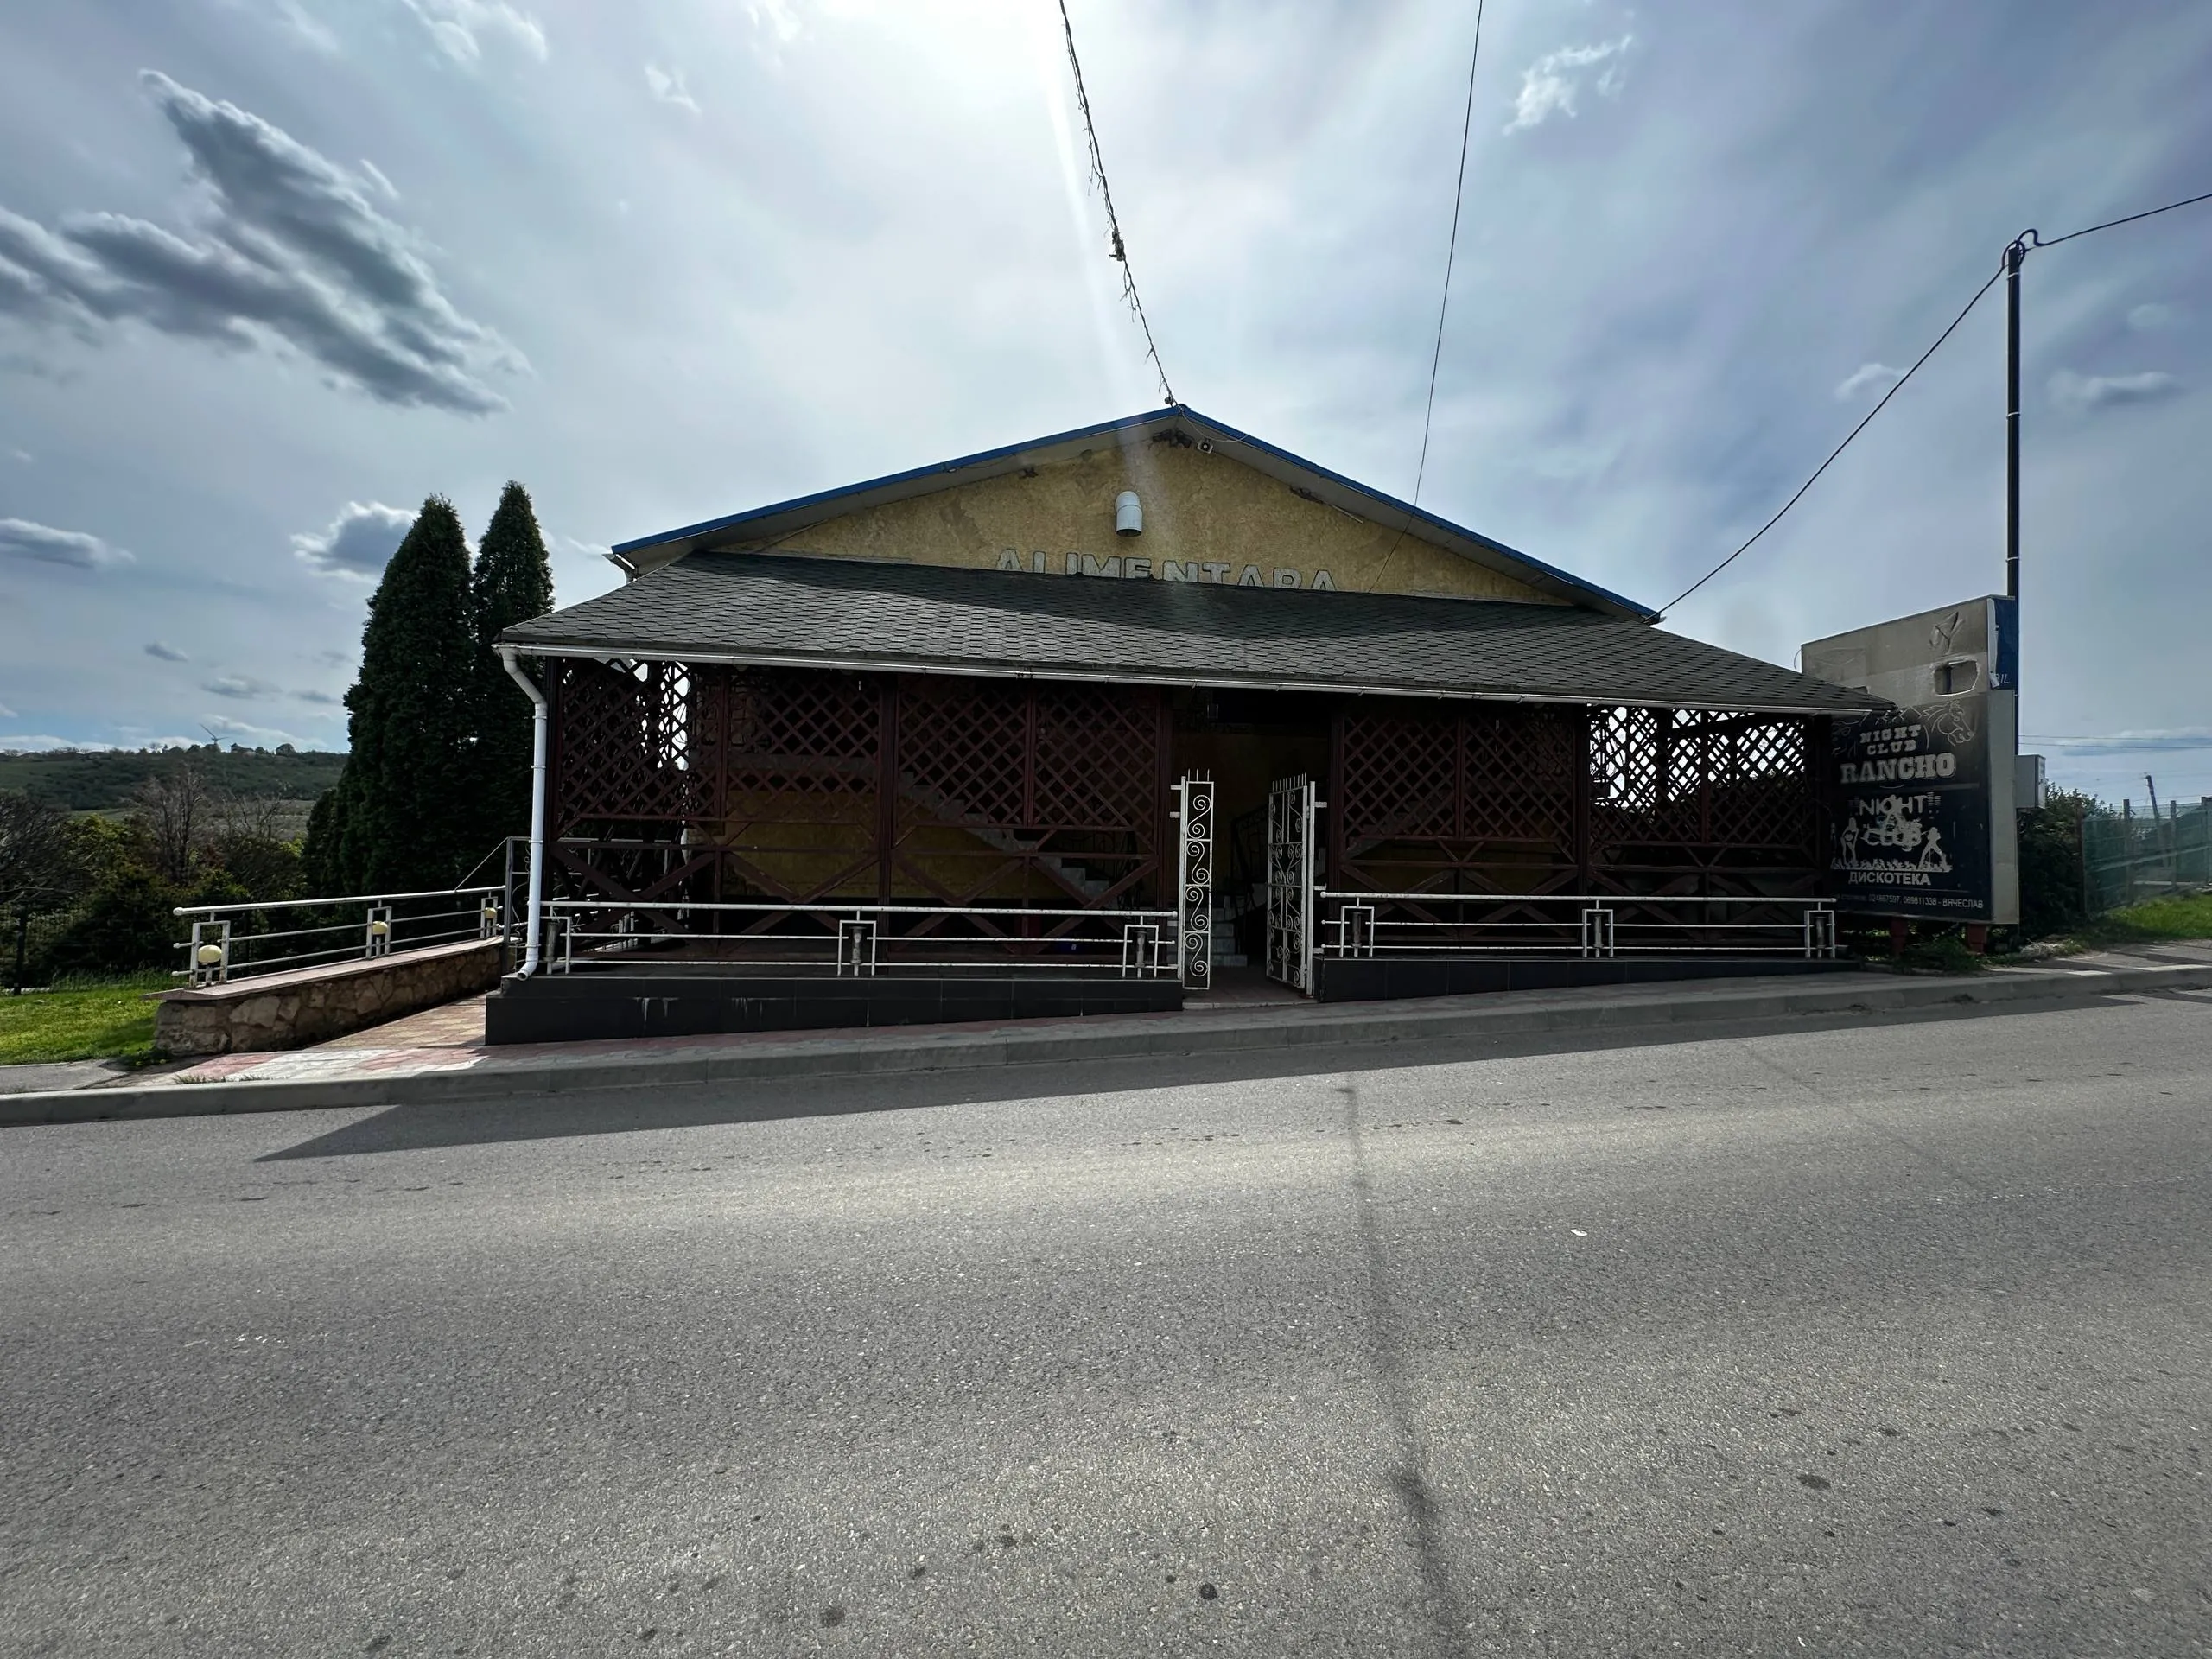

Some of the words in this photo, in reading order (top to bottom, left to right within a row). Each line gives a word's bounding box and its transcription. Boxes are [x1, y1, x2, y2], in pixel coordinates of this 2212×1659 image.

[1859, 724, 1921, 744] NIGHT
[1866, 739, 1917, 755] CLUB
[1840, 753, 1956, 784] RANCHO
[1847, 871, 1931, 886] ДИСКОТЕКА
[1942, 898, 1984, 908] ВЯЧЕСЛАВ
